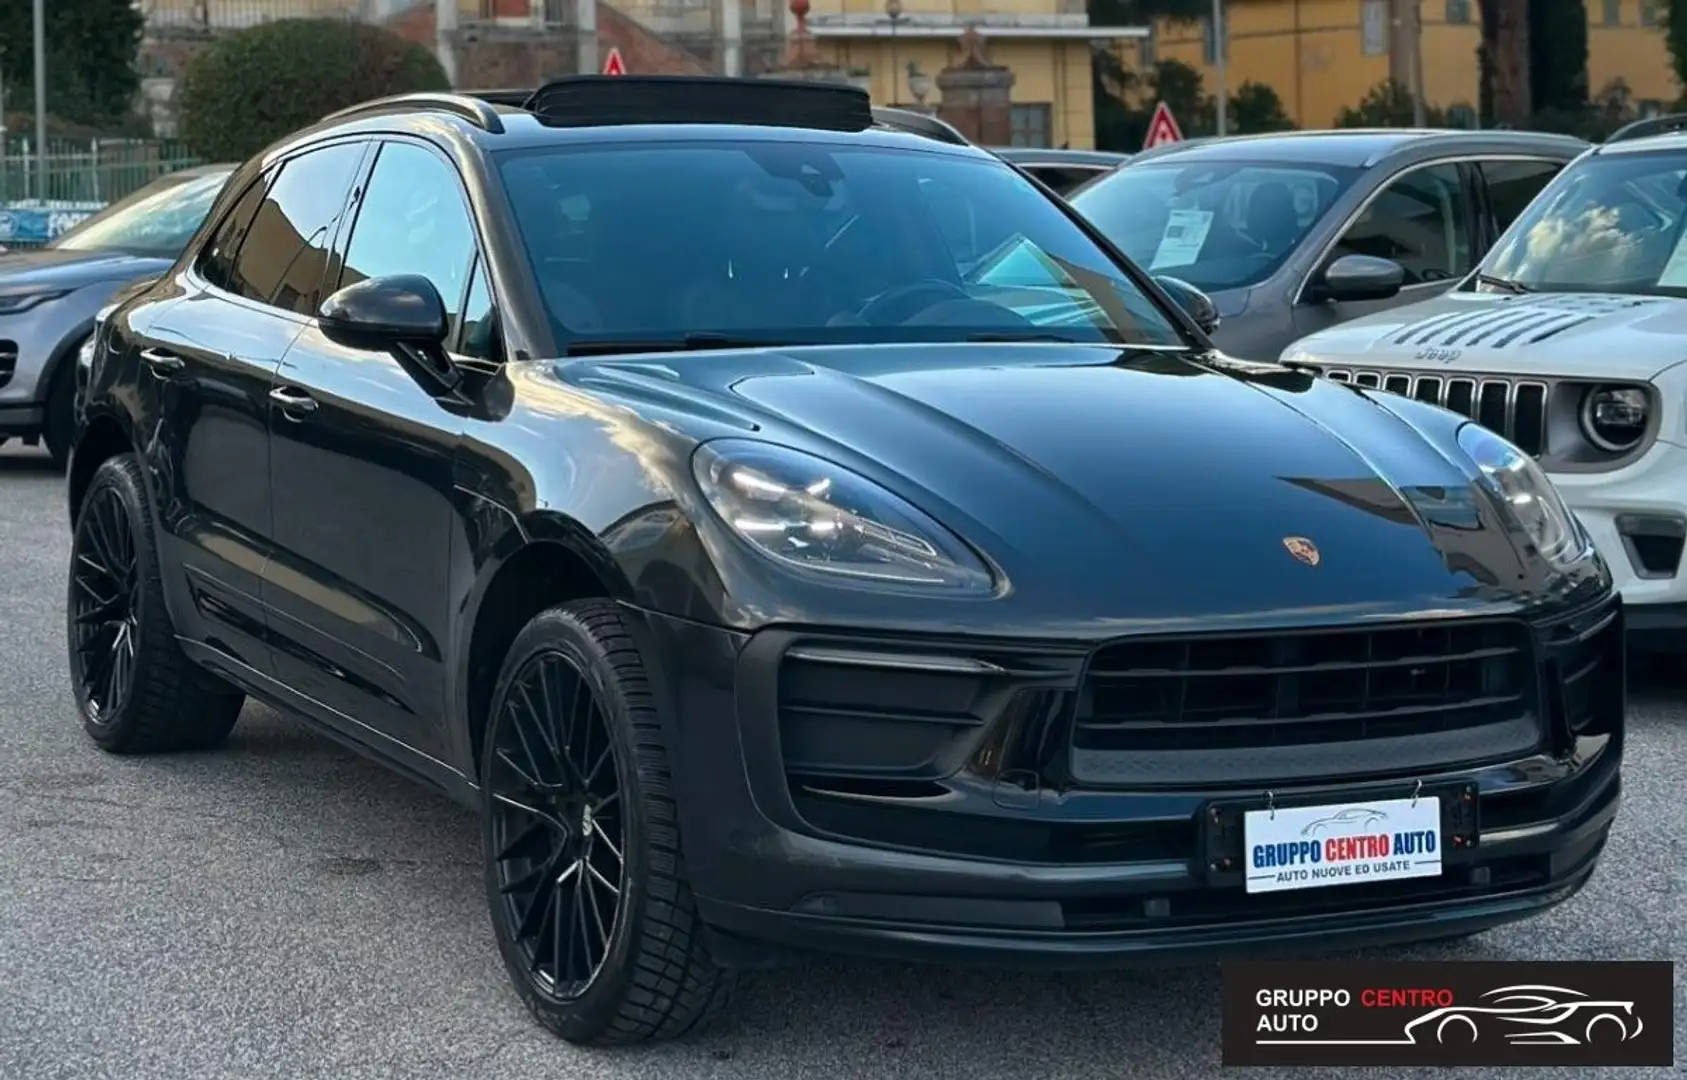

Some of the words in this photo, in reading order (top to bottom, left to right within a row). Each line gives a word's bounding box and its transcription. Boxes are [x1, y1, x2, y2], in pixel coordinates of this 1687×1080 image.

[1253, 840, 1322, 868] GRUPPO
[1325, 834, 1390, 862] CENTRO
[1393, 830, 1436, 855] AUTO
[1276, 871, 1308, 882] AUTO
[1312, 865, 1352, 879] NUOVE
[1355, 863, 1369, 874] ED
[1373, 860, 1410, 873] USATE
